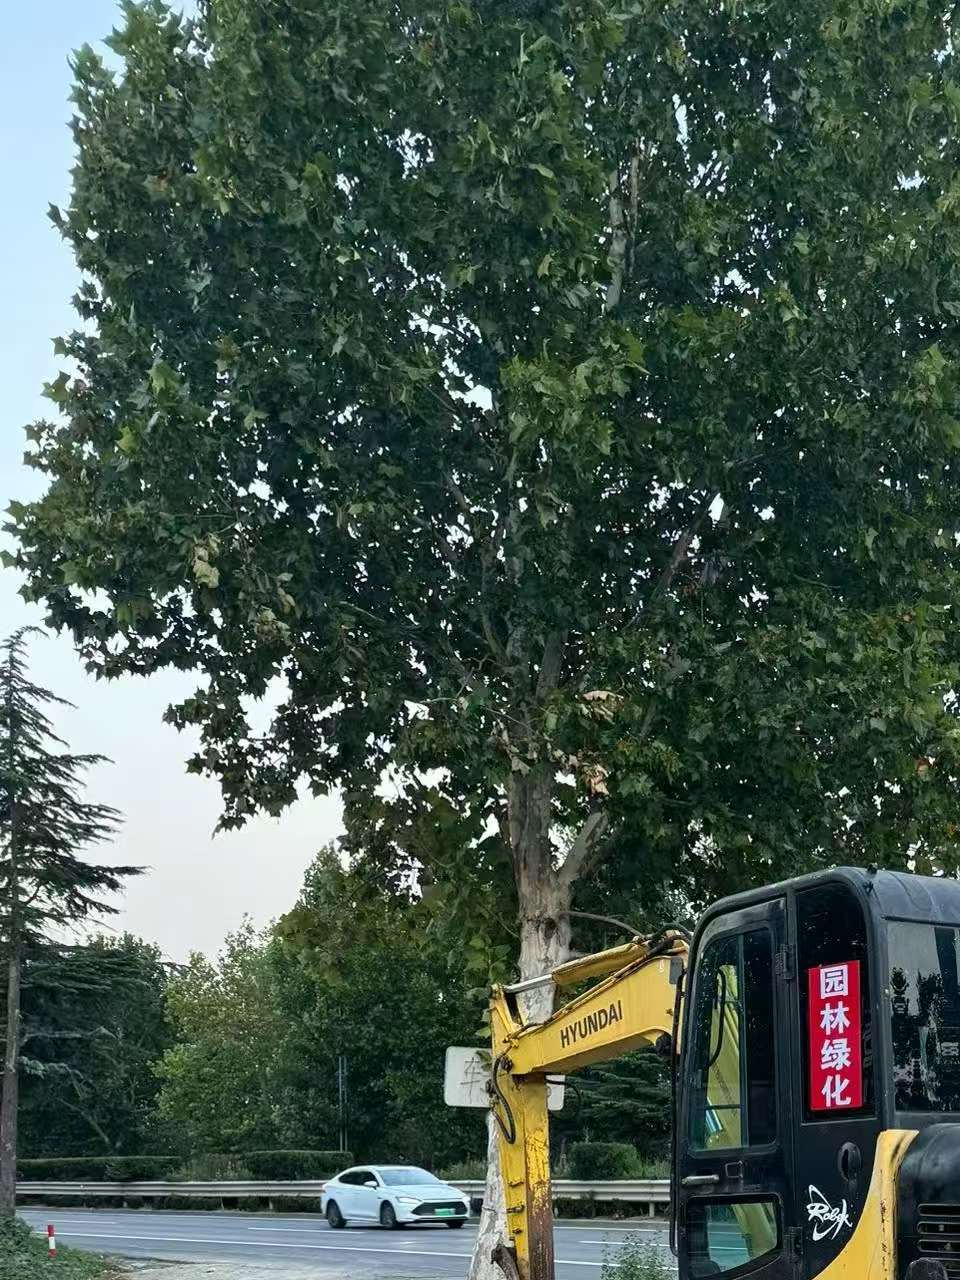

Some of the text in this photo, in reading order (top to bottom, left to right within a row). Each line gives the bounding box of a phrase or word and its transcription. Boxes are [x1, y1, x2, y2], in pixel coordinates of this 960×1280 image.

[560, 999, 623, 1048] HYUNDAI
[819, 964, 852, 1107] 园林绿化
